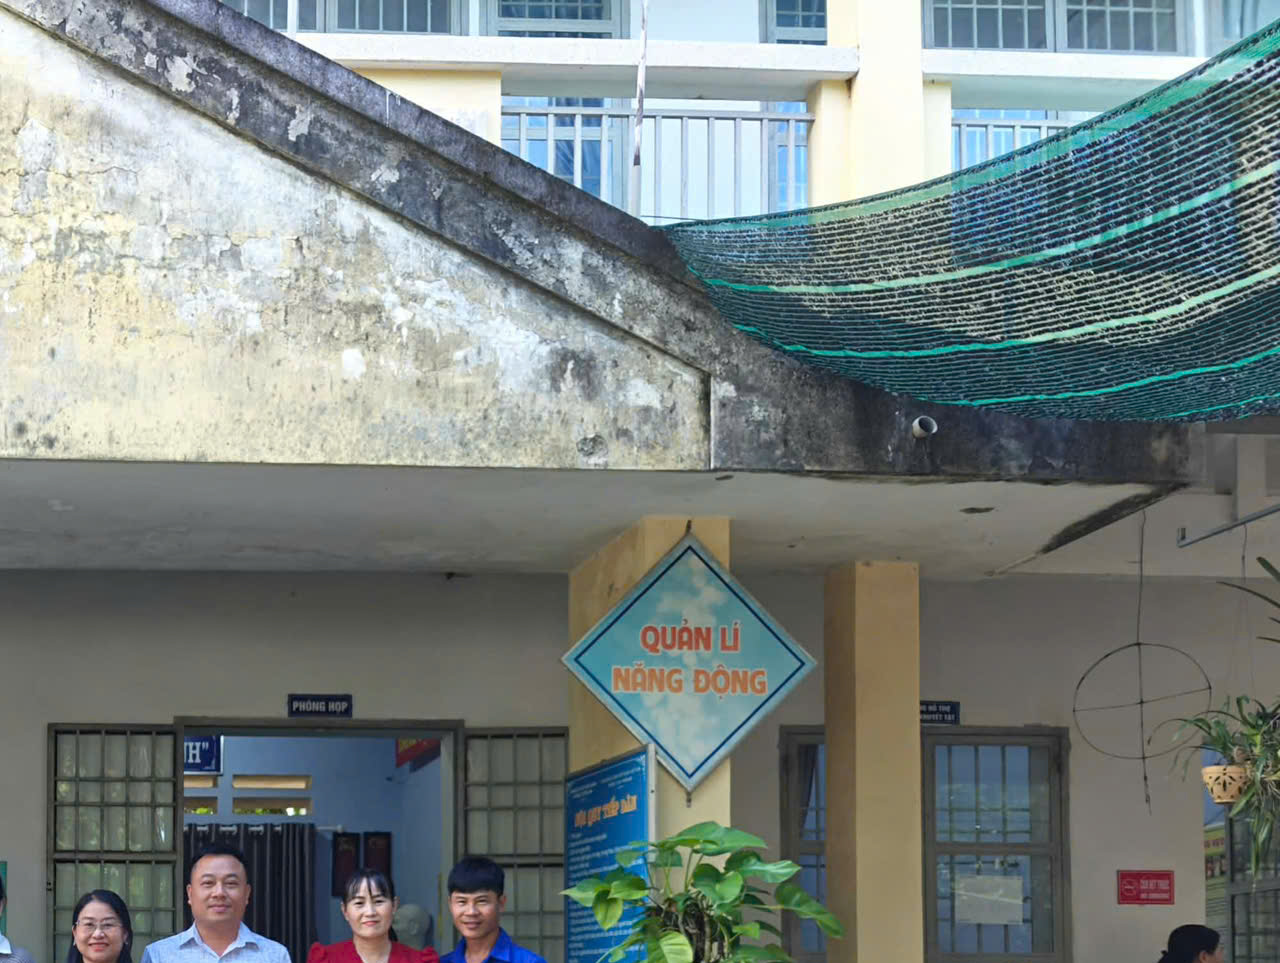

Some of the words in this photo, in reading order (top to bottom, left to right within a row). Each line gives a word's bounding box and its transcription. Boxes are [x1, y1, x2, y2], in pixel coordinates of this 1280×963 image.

[640, 619, 711, 654] QUẢN
[720, 621, 741, 653] LÍ
[612, 662, 683, 693] NĂNG
[693, 664, 768, 700] ĐỘNG
[292, 699, 326, 712] PHÒNG
[328, 701, 348, 714] HỌP
